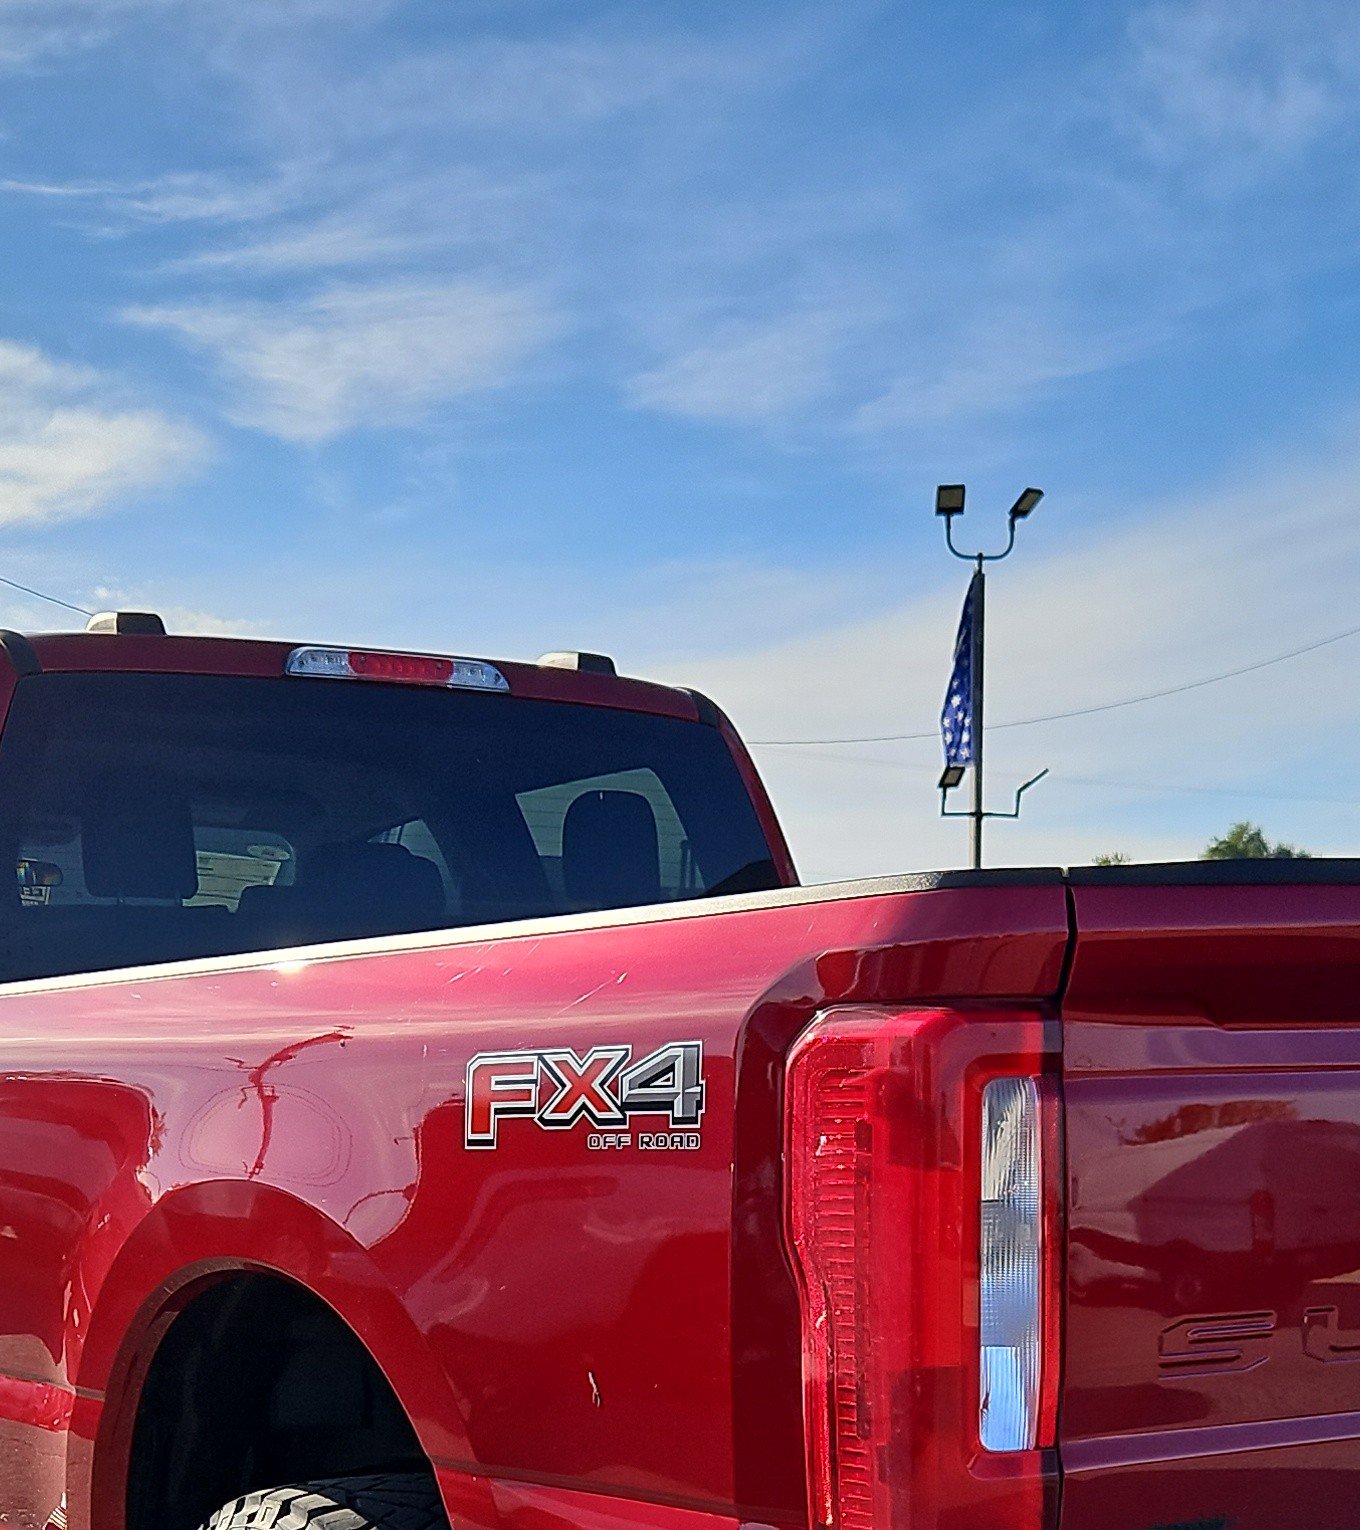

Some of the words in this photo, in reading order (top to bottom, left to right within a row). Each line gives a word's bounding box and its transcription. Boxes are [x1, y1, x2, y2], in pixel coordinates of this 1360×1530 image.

[465, 1041, 706, 1150] FX4
[588, 1134, 632, 1150] OFF
[639, 1133, 701, 1150] ROAD
